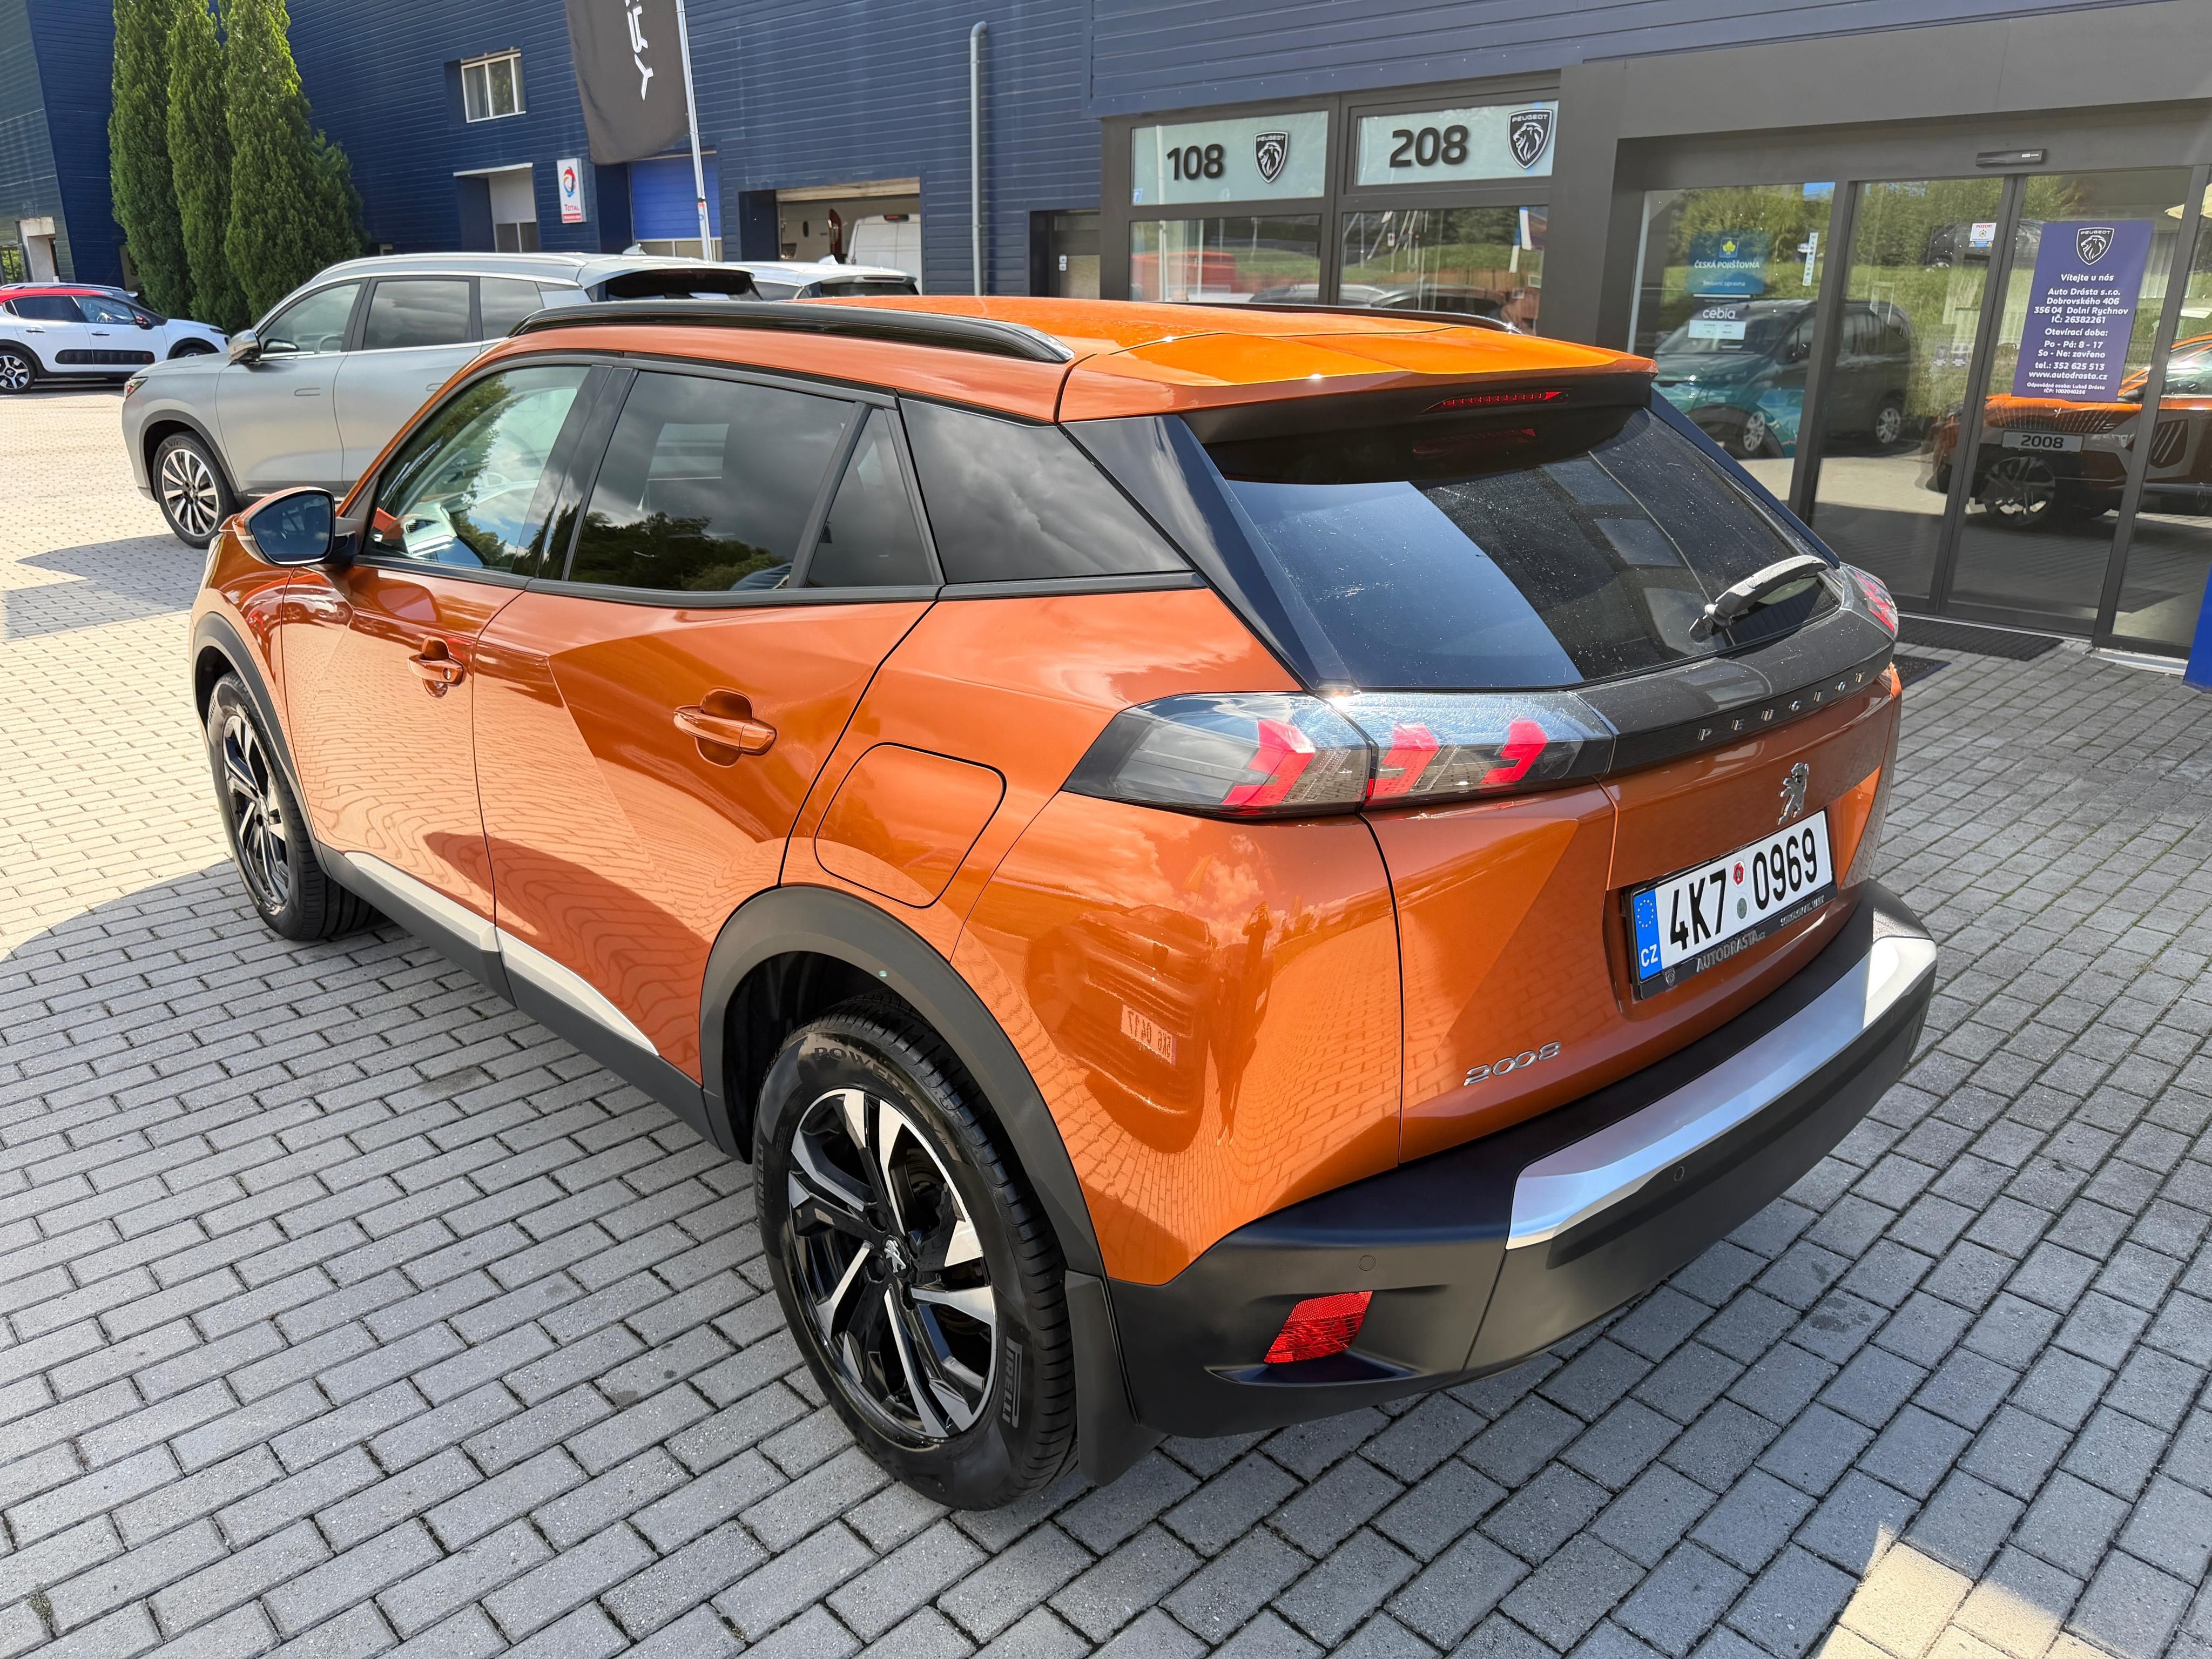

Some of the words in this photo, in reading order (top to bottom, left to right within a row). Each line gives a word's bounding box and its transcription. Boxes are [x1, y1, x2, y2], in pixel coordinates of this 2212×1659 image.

[1512, 114, 1548, 123] PEUGEOT
[1390, 125, 1468, 167] 208
[1166, 144, 1224, 181] 108
[1694, 260, 1716, 268] ČESKÁ
[2061, 274, 2089, 282] Vítejte
[1702, 307, 1736, 319] cebia
[2092, 307, 2129, 316] Rychnov
[2051, 314, 2063, 323] IČ:
[2045, 328, 2083, 336] Otevírací
[2085, 328, 2108, 336] doba:
[2072, 350, 2106, 359] zavřeno
[2028, 371, 2108, 380] www.autodrasta.cz
[2021, 435, 2064, 449] 2008
[1697, 671, 1865, 741] PEUGEOT
[1670, 868, 1727, 951] 4K7
[1752, 827, 1818, 911] 0969
[1641, 943, 1658, 967] CZ
[1463, 1041, 1561, 1087] 2008
[1002, 1336, 1023, 1428] PIRELLI
